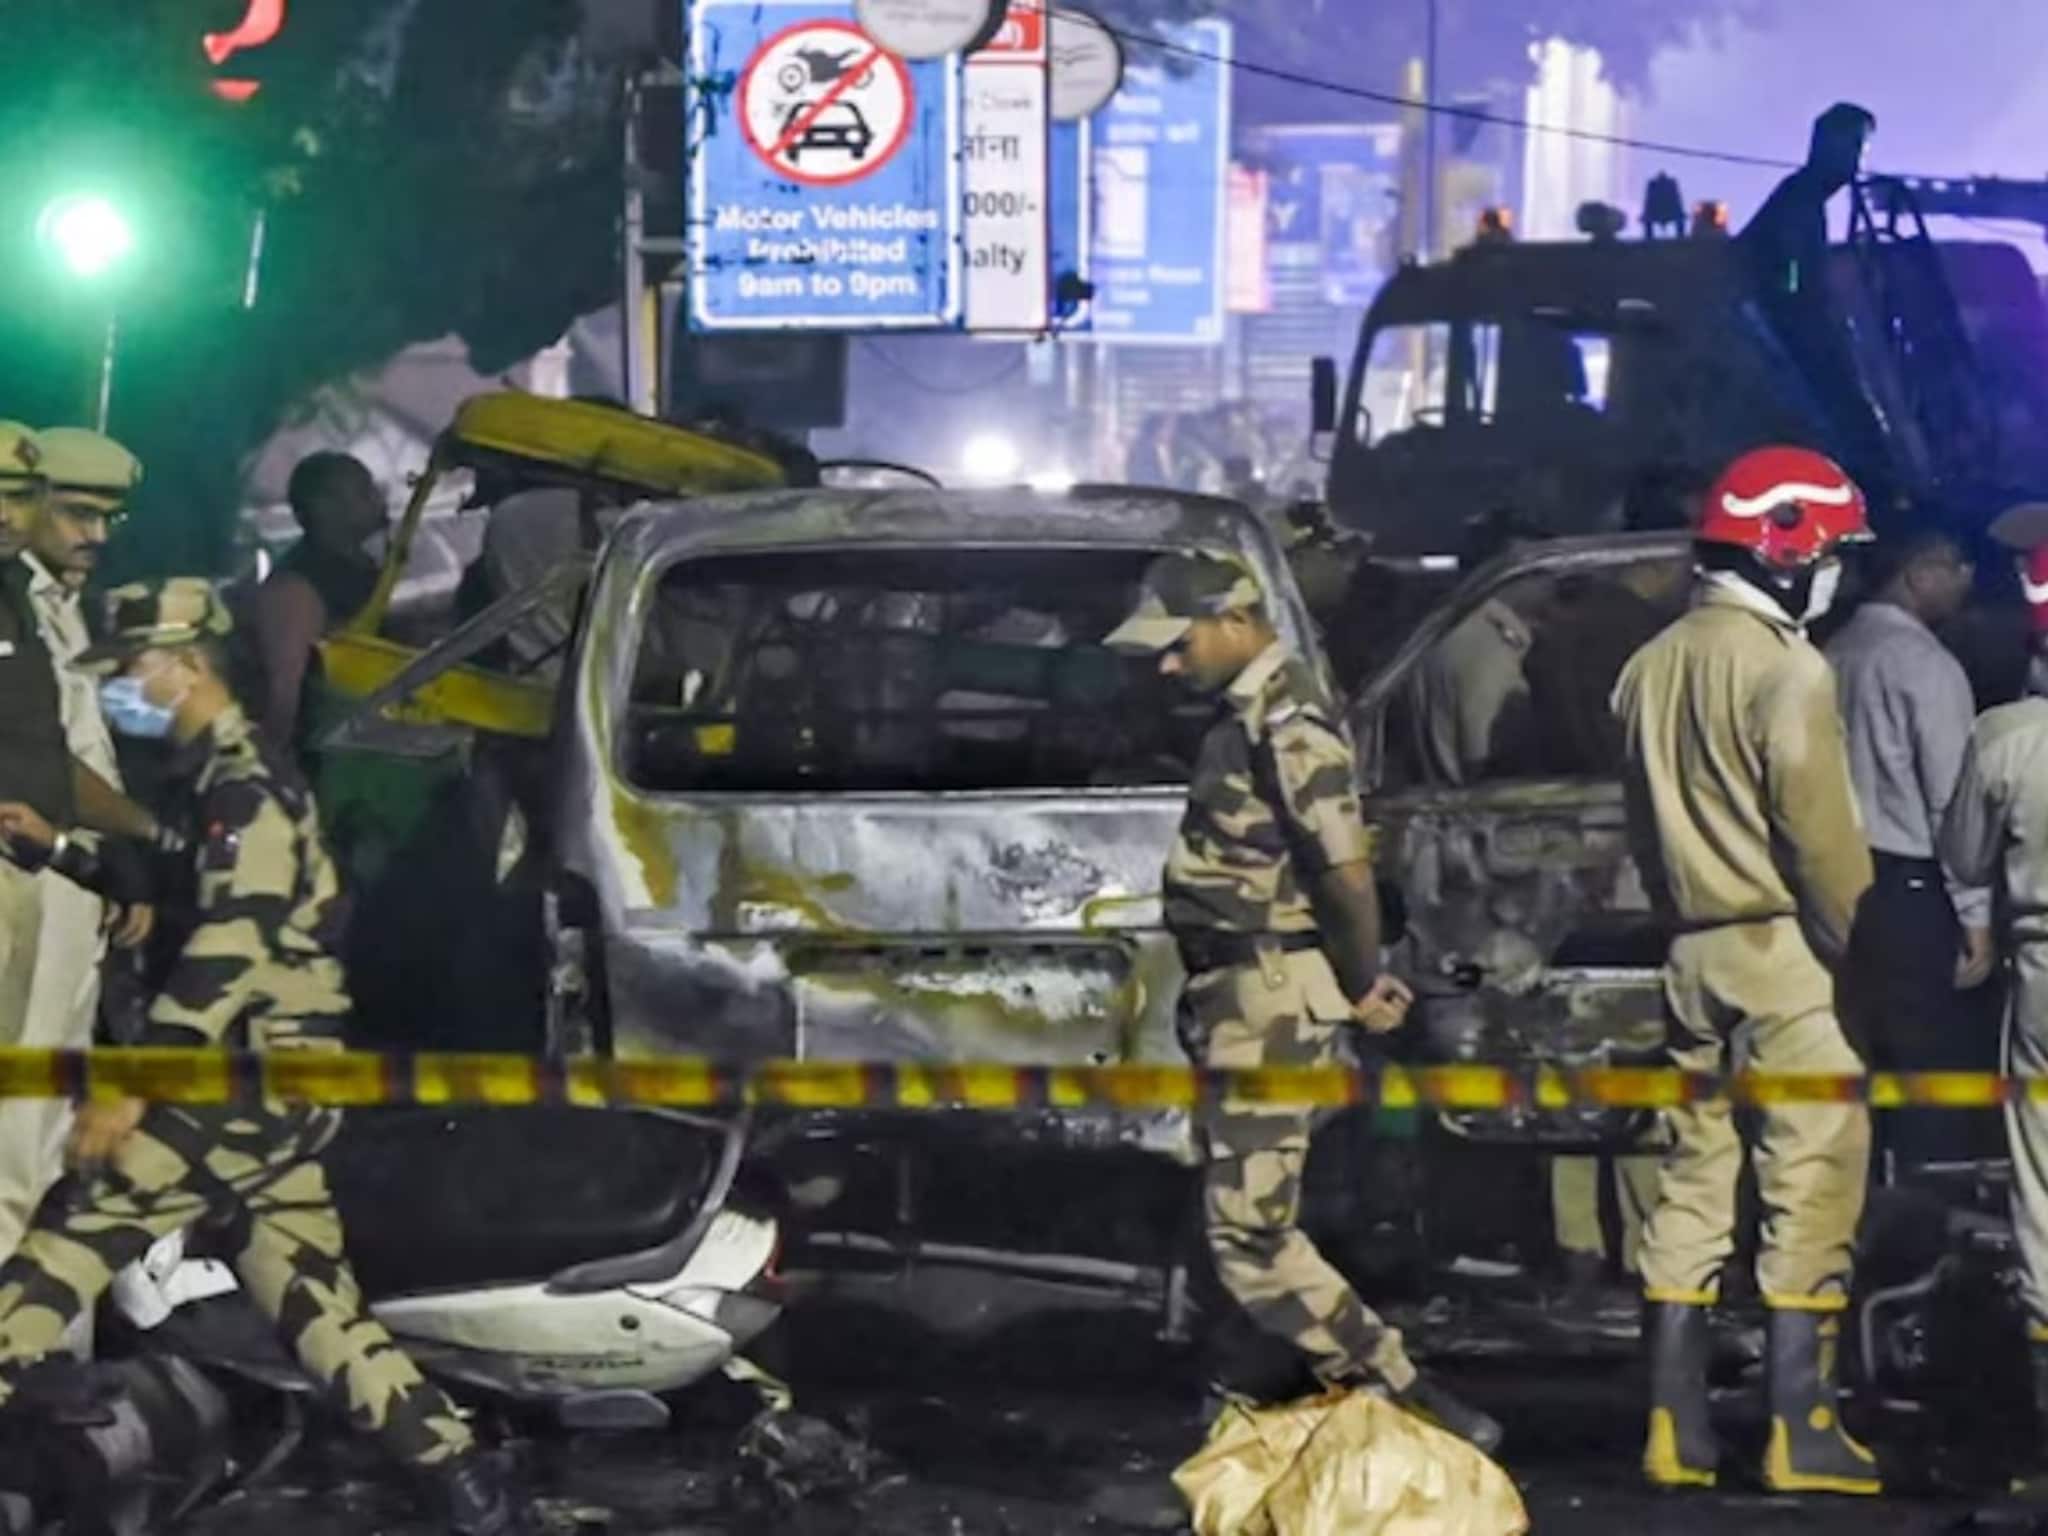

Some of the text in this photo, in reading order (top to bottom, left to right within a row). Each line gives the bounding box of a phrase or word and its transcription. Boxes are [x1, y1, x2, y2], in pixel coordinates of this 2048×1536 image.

[715, 203, 939, 229] Motor Vehicles
[748, 237, 907, 263] Prohibited
[811, 272, 842, 297] to
